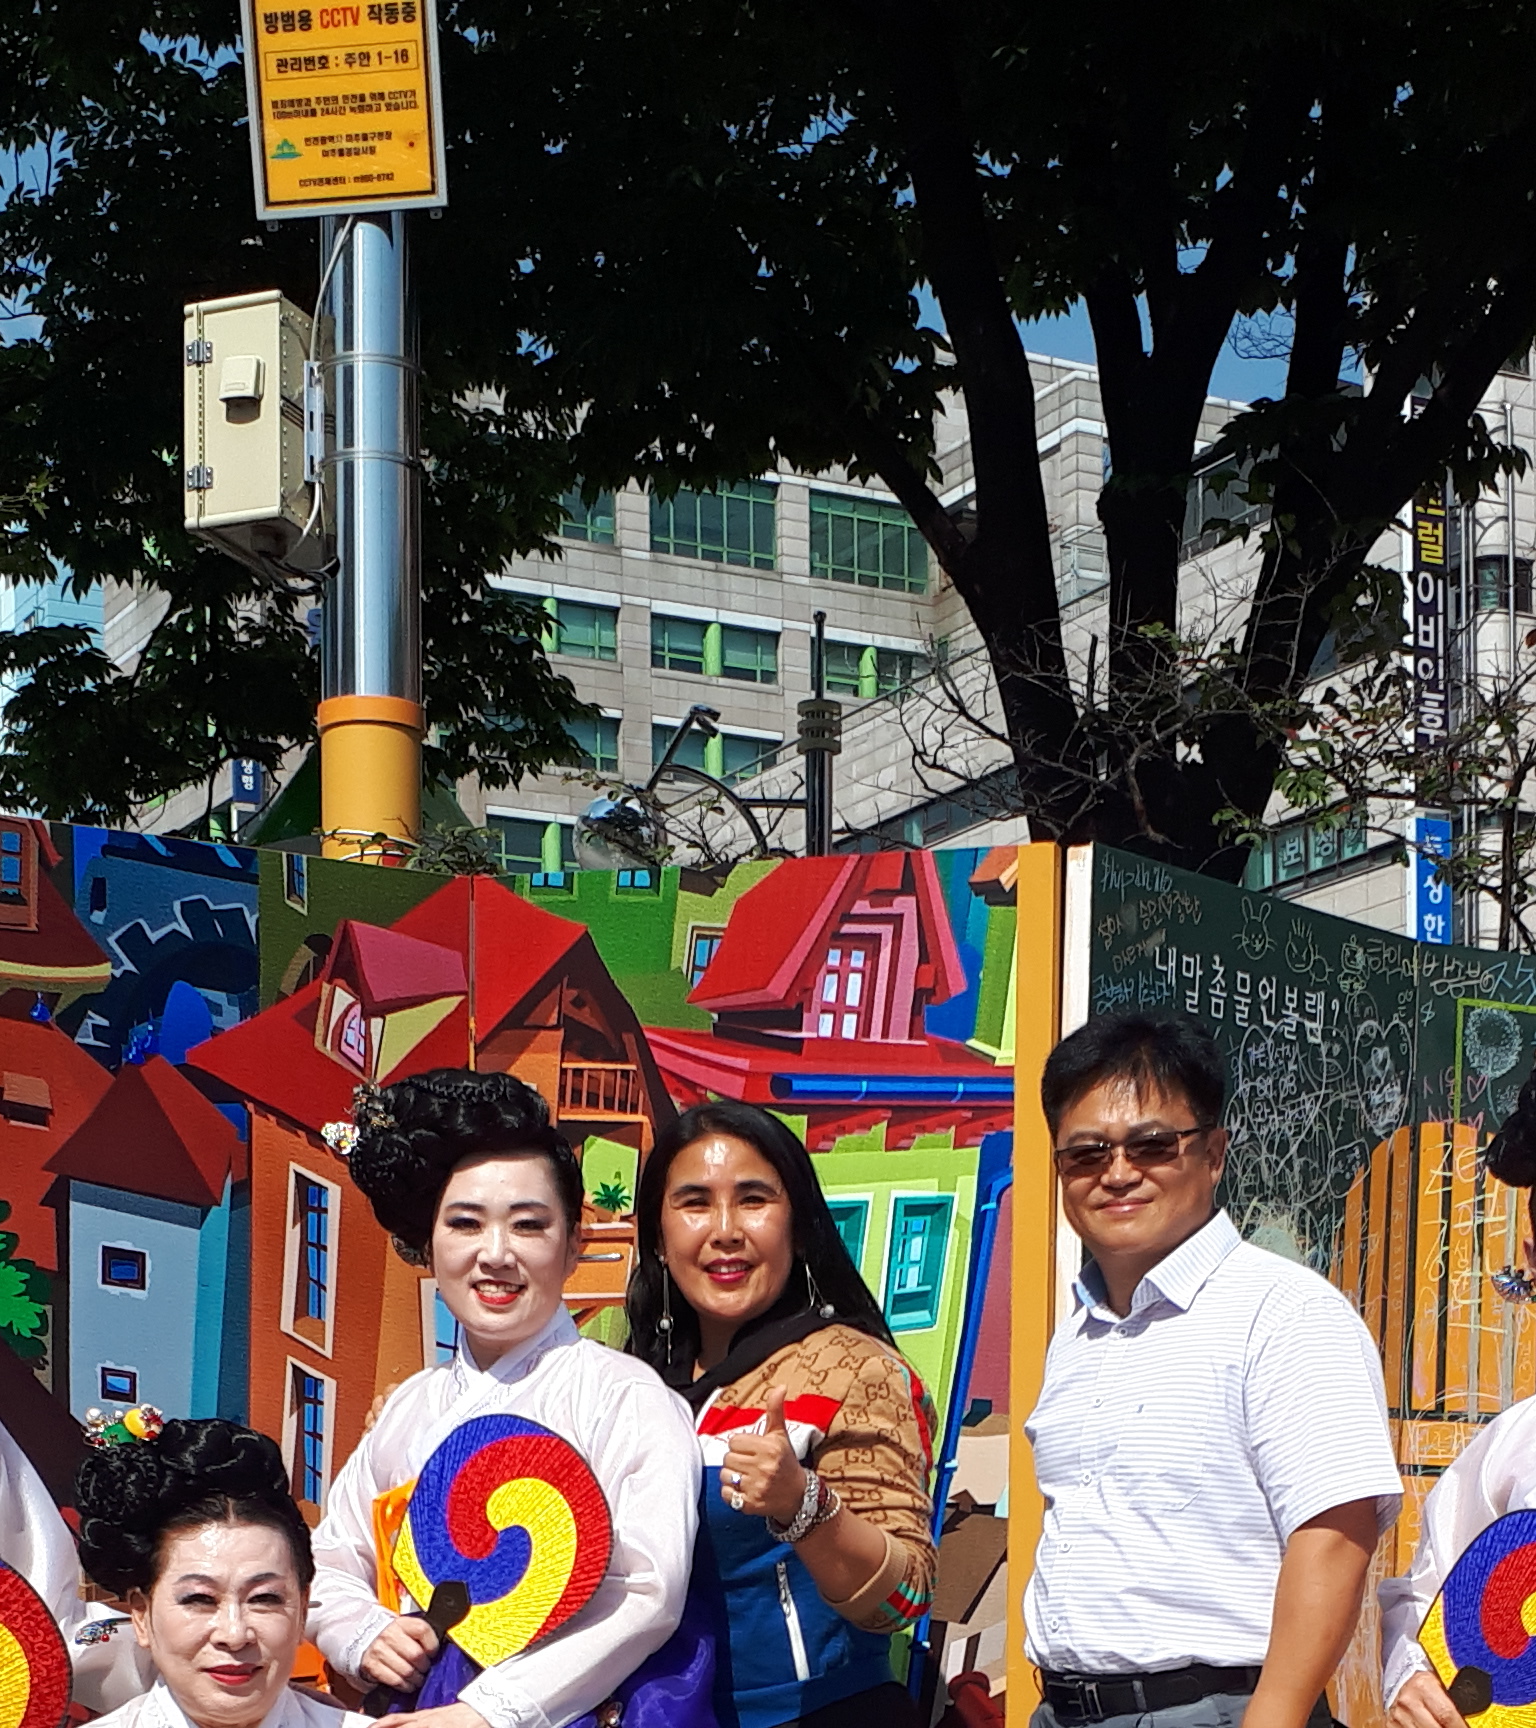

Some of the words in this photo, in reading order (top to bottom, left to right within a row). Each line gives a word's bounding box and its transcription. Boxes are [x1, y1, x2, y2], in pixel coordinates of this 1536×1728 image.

[264, 9, 312, 34] 방범용
[319, 5, 360, 29] CCTV
[367, 1, 416, 25] 작동중
[275, 55, 330, 74] 관리번호
[344, 51, 371, 69] 주안
